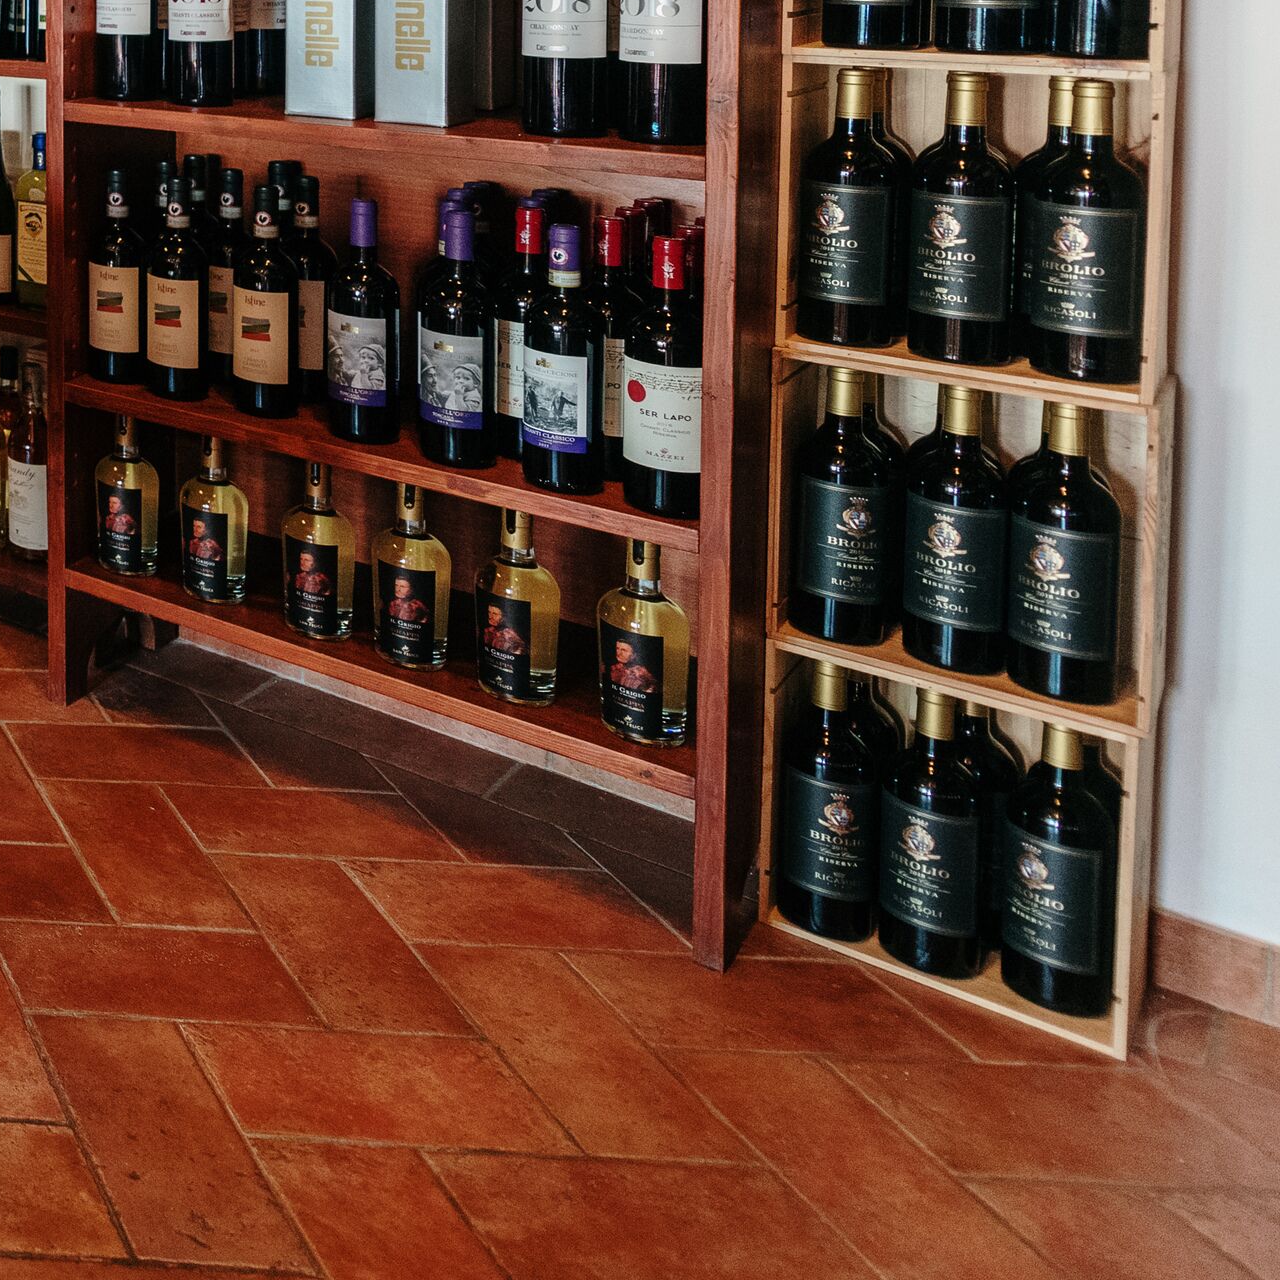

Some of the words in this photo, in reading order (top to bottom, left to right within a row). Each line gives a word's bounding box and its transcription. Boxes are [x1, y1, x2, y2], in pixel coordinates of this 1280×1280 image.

[639, 407, 658, 417] SER
[663, 412, 692, 422] LAPO
[542, 432, 576, 444] CLASSICO
[645, 448, 686, 461] MAZZEI
